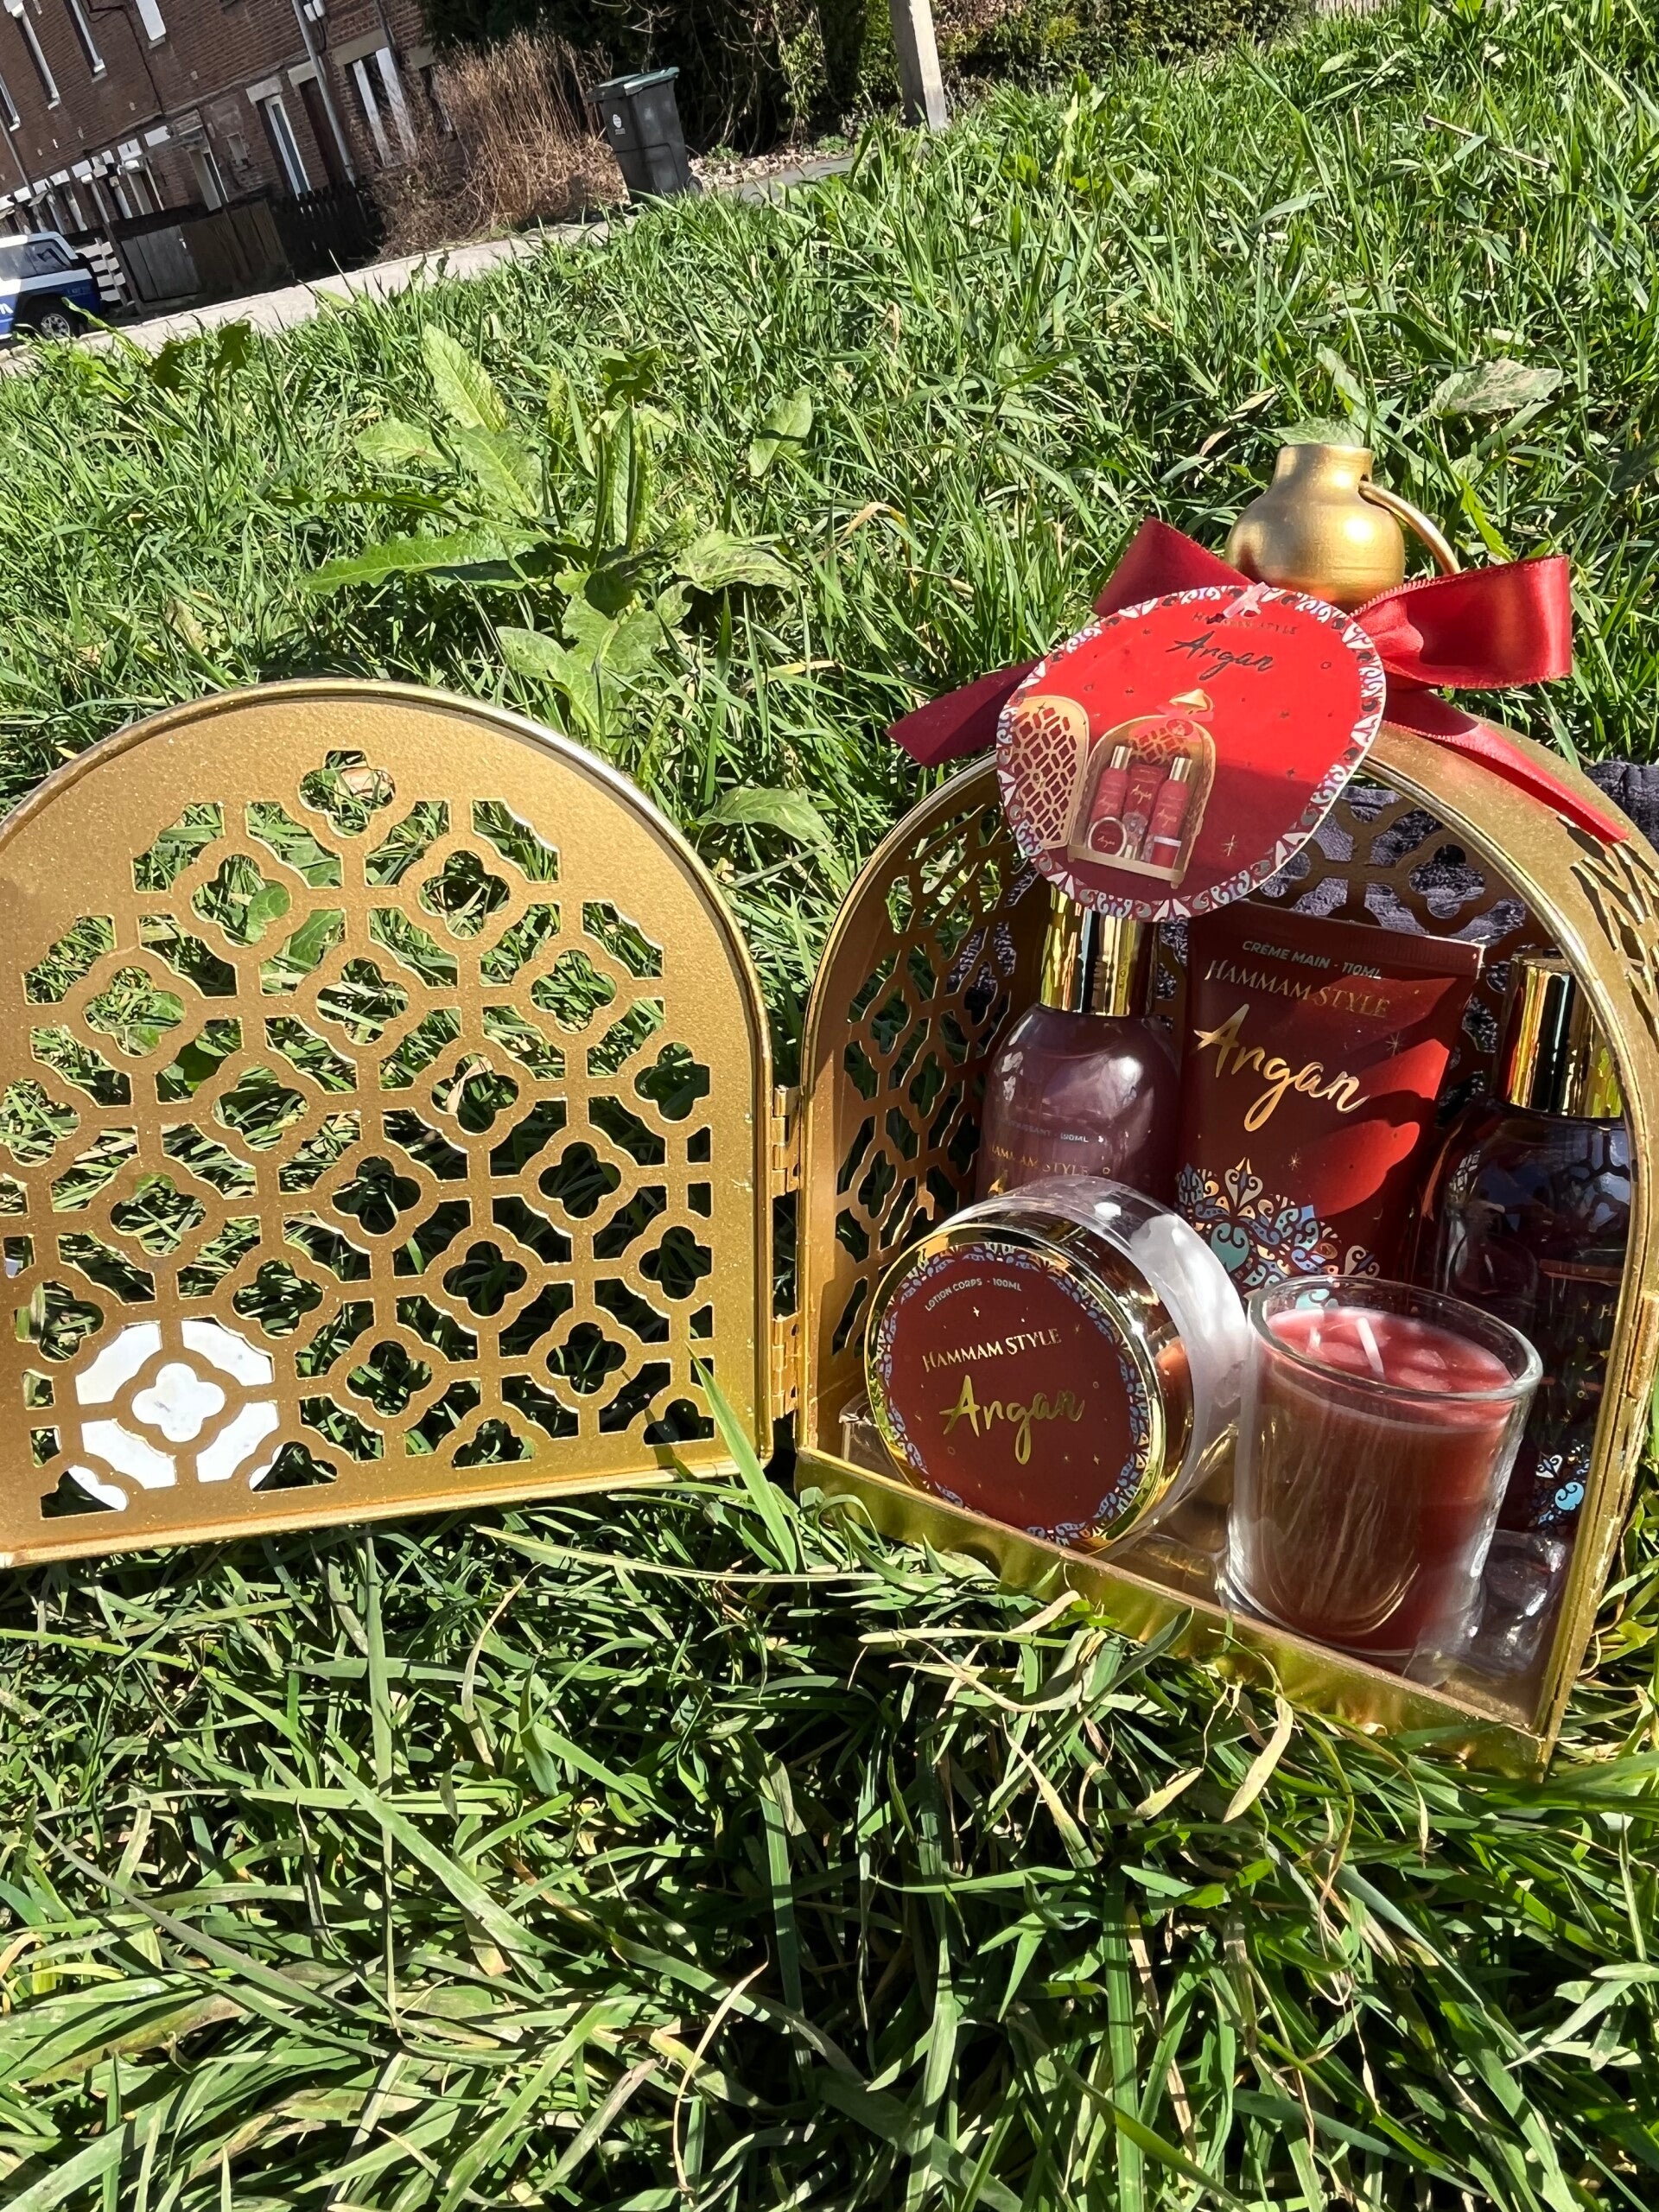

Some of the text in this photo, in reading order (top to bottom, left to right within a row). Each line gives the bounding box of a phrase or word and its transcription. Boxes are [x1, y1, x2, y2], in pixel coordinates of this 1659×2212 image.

[1165, 630, 1274, 681] Argan
[1291, 951, 1332, 969] MAIN
[1204, 959, 1391, 1018] HAMMAM STYLE
[1193, 1003, 1370, 1132] Argan
[925, 1287, 952, 1312] LOTION
[952, 1278, 982, 1291] CORPS
[992, 1278, 1022, 1291] 100ML
[922, 1328, 1062, 1373] HAMMAM STYLE
[939, 1375, 1086, 1465] Argan
